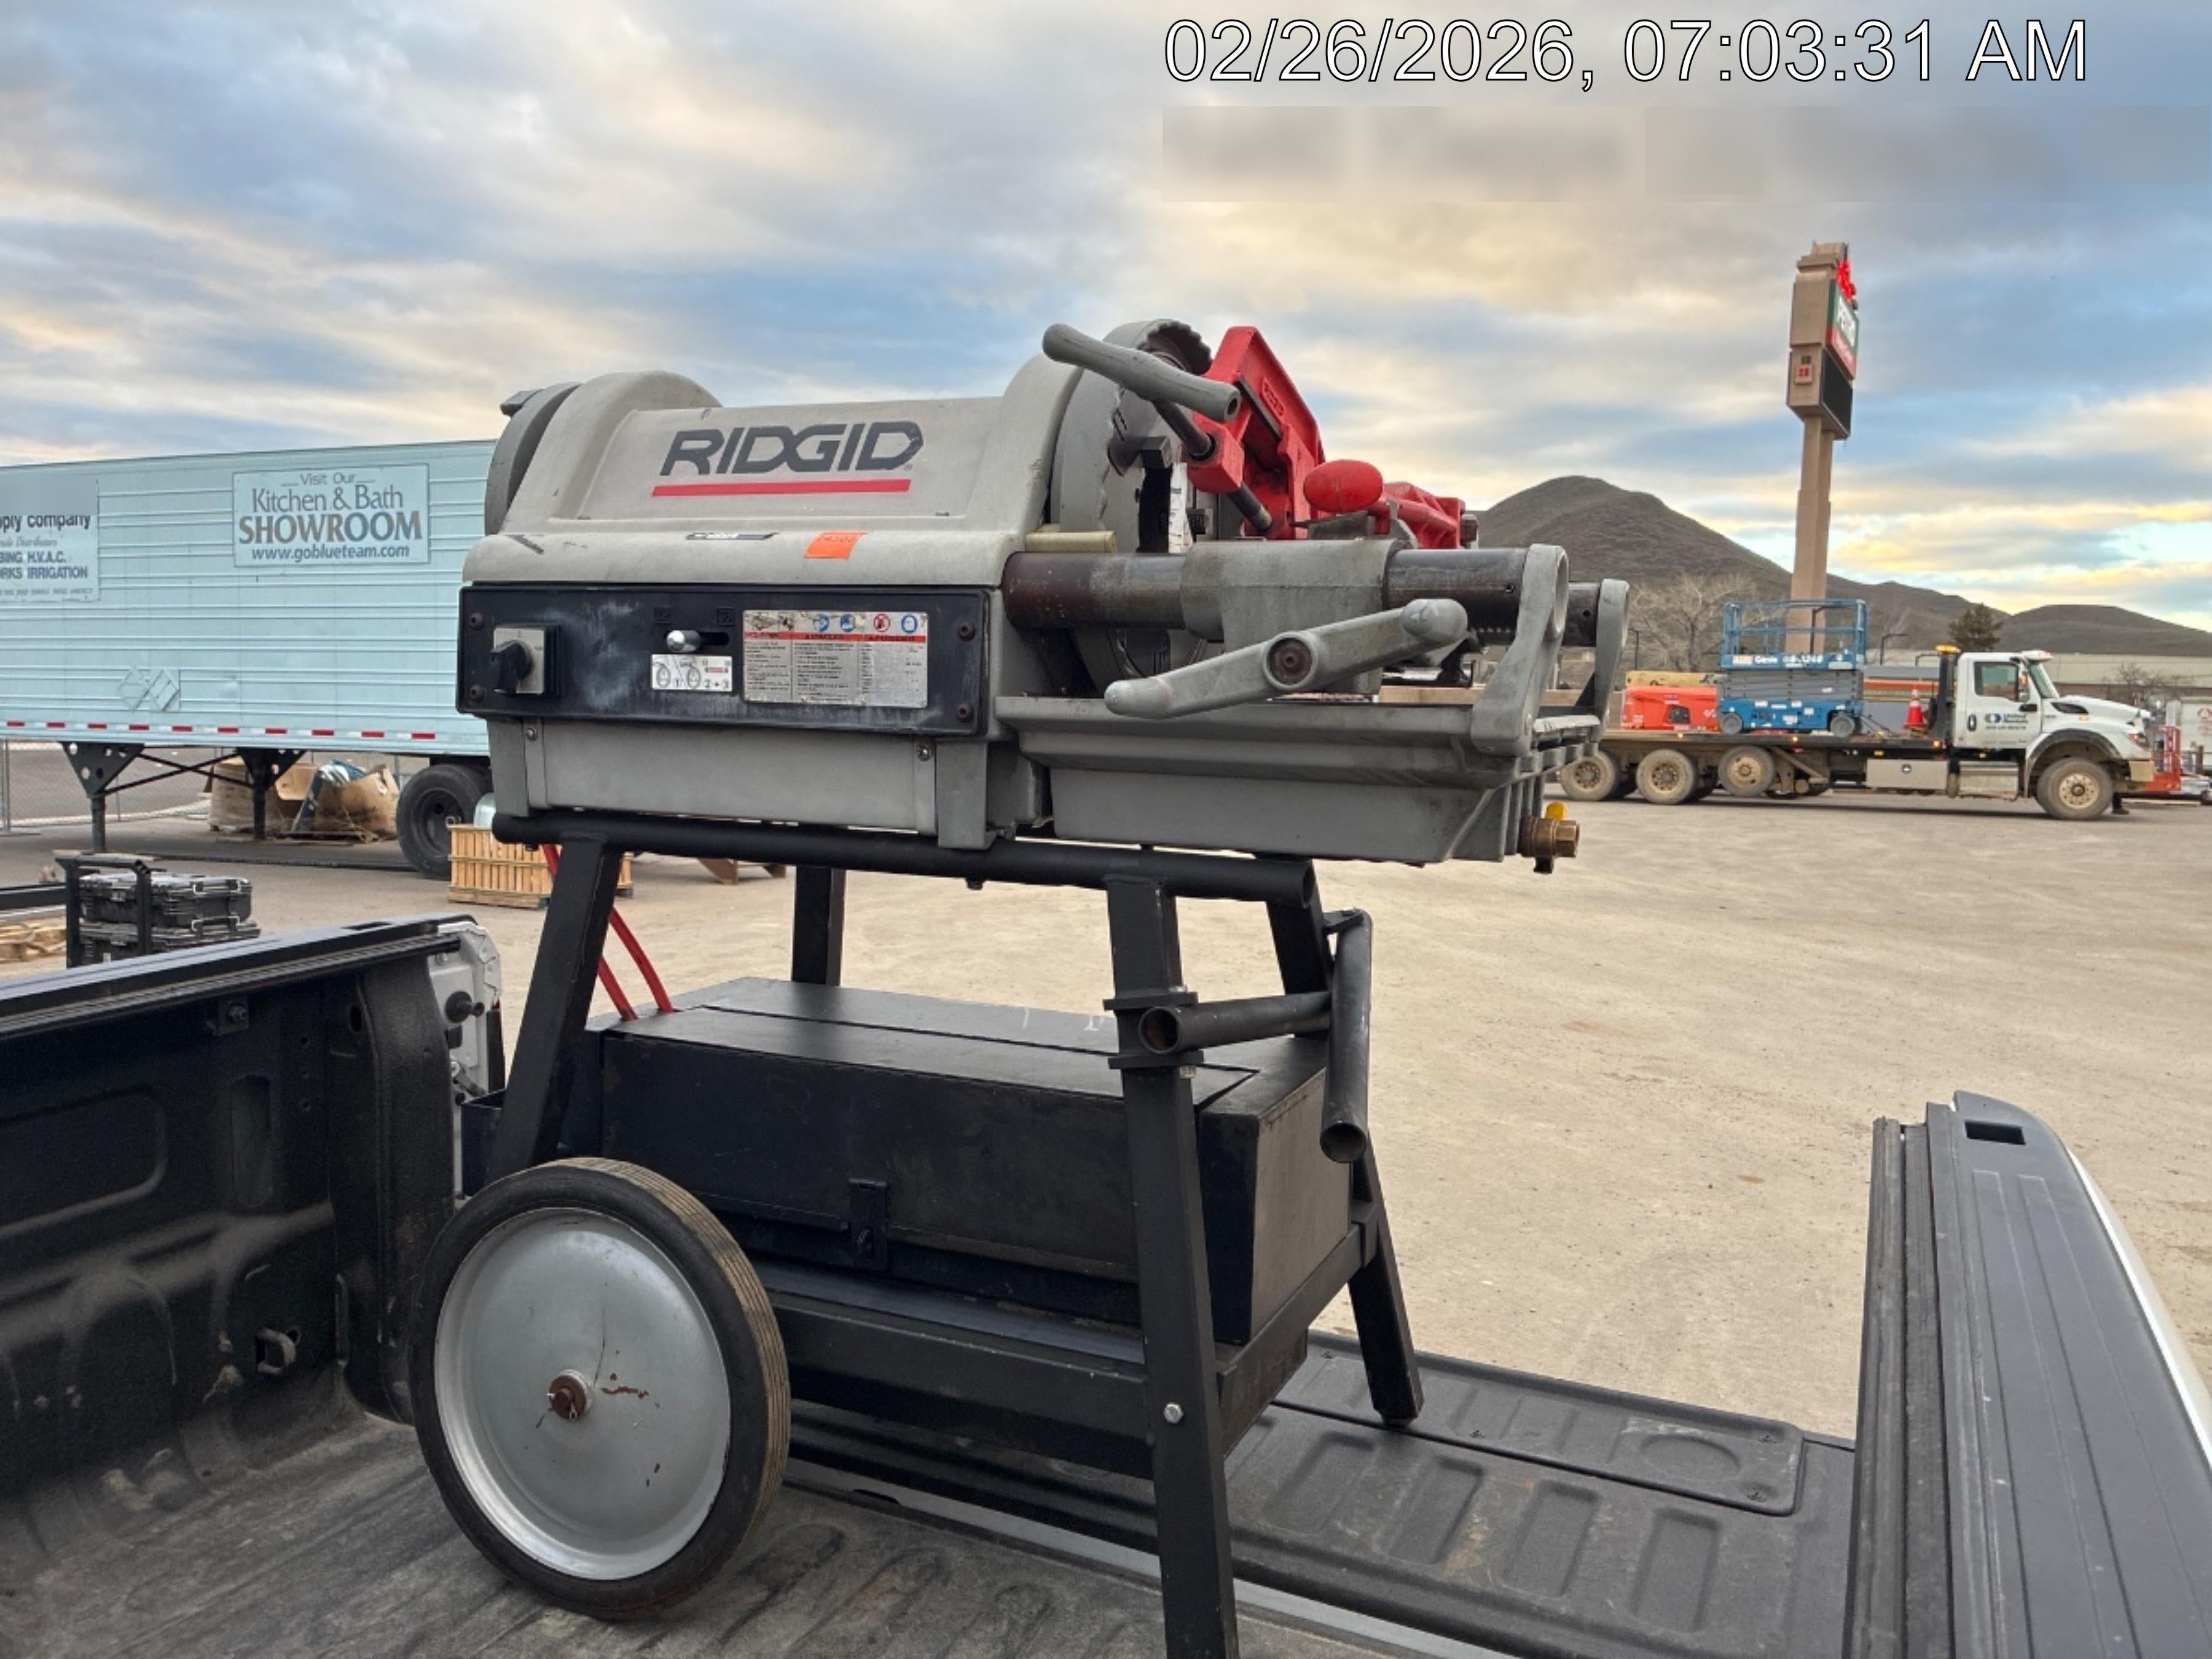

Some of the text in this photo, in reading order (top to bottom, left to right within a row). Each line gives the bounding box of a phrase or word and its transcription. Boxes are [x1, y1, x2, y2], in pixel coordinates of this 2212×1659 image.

[659, 421, 924, 476] RIDGID
[300, 472, 356, 485] Visit Our
[252, 484, 402, 512] Kitchen & Bath
[27, 515, 91, 531] company
[239, 511, 422, 544] SHOWROOM
[28, 551, 67, 563] H.V.A.C.
[252, 544, 409, 562] www.goblueteam.com
[28, 566, 88, 579] IRRIGATION
